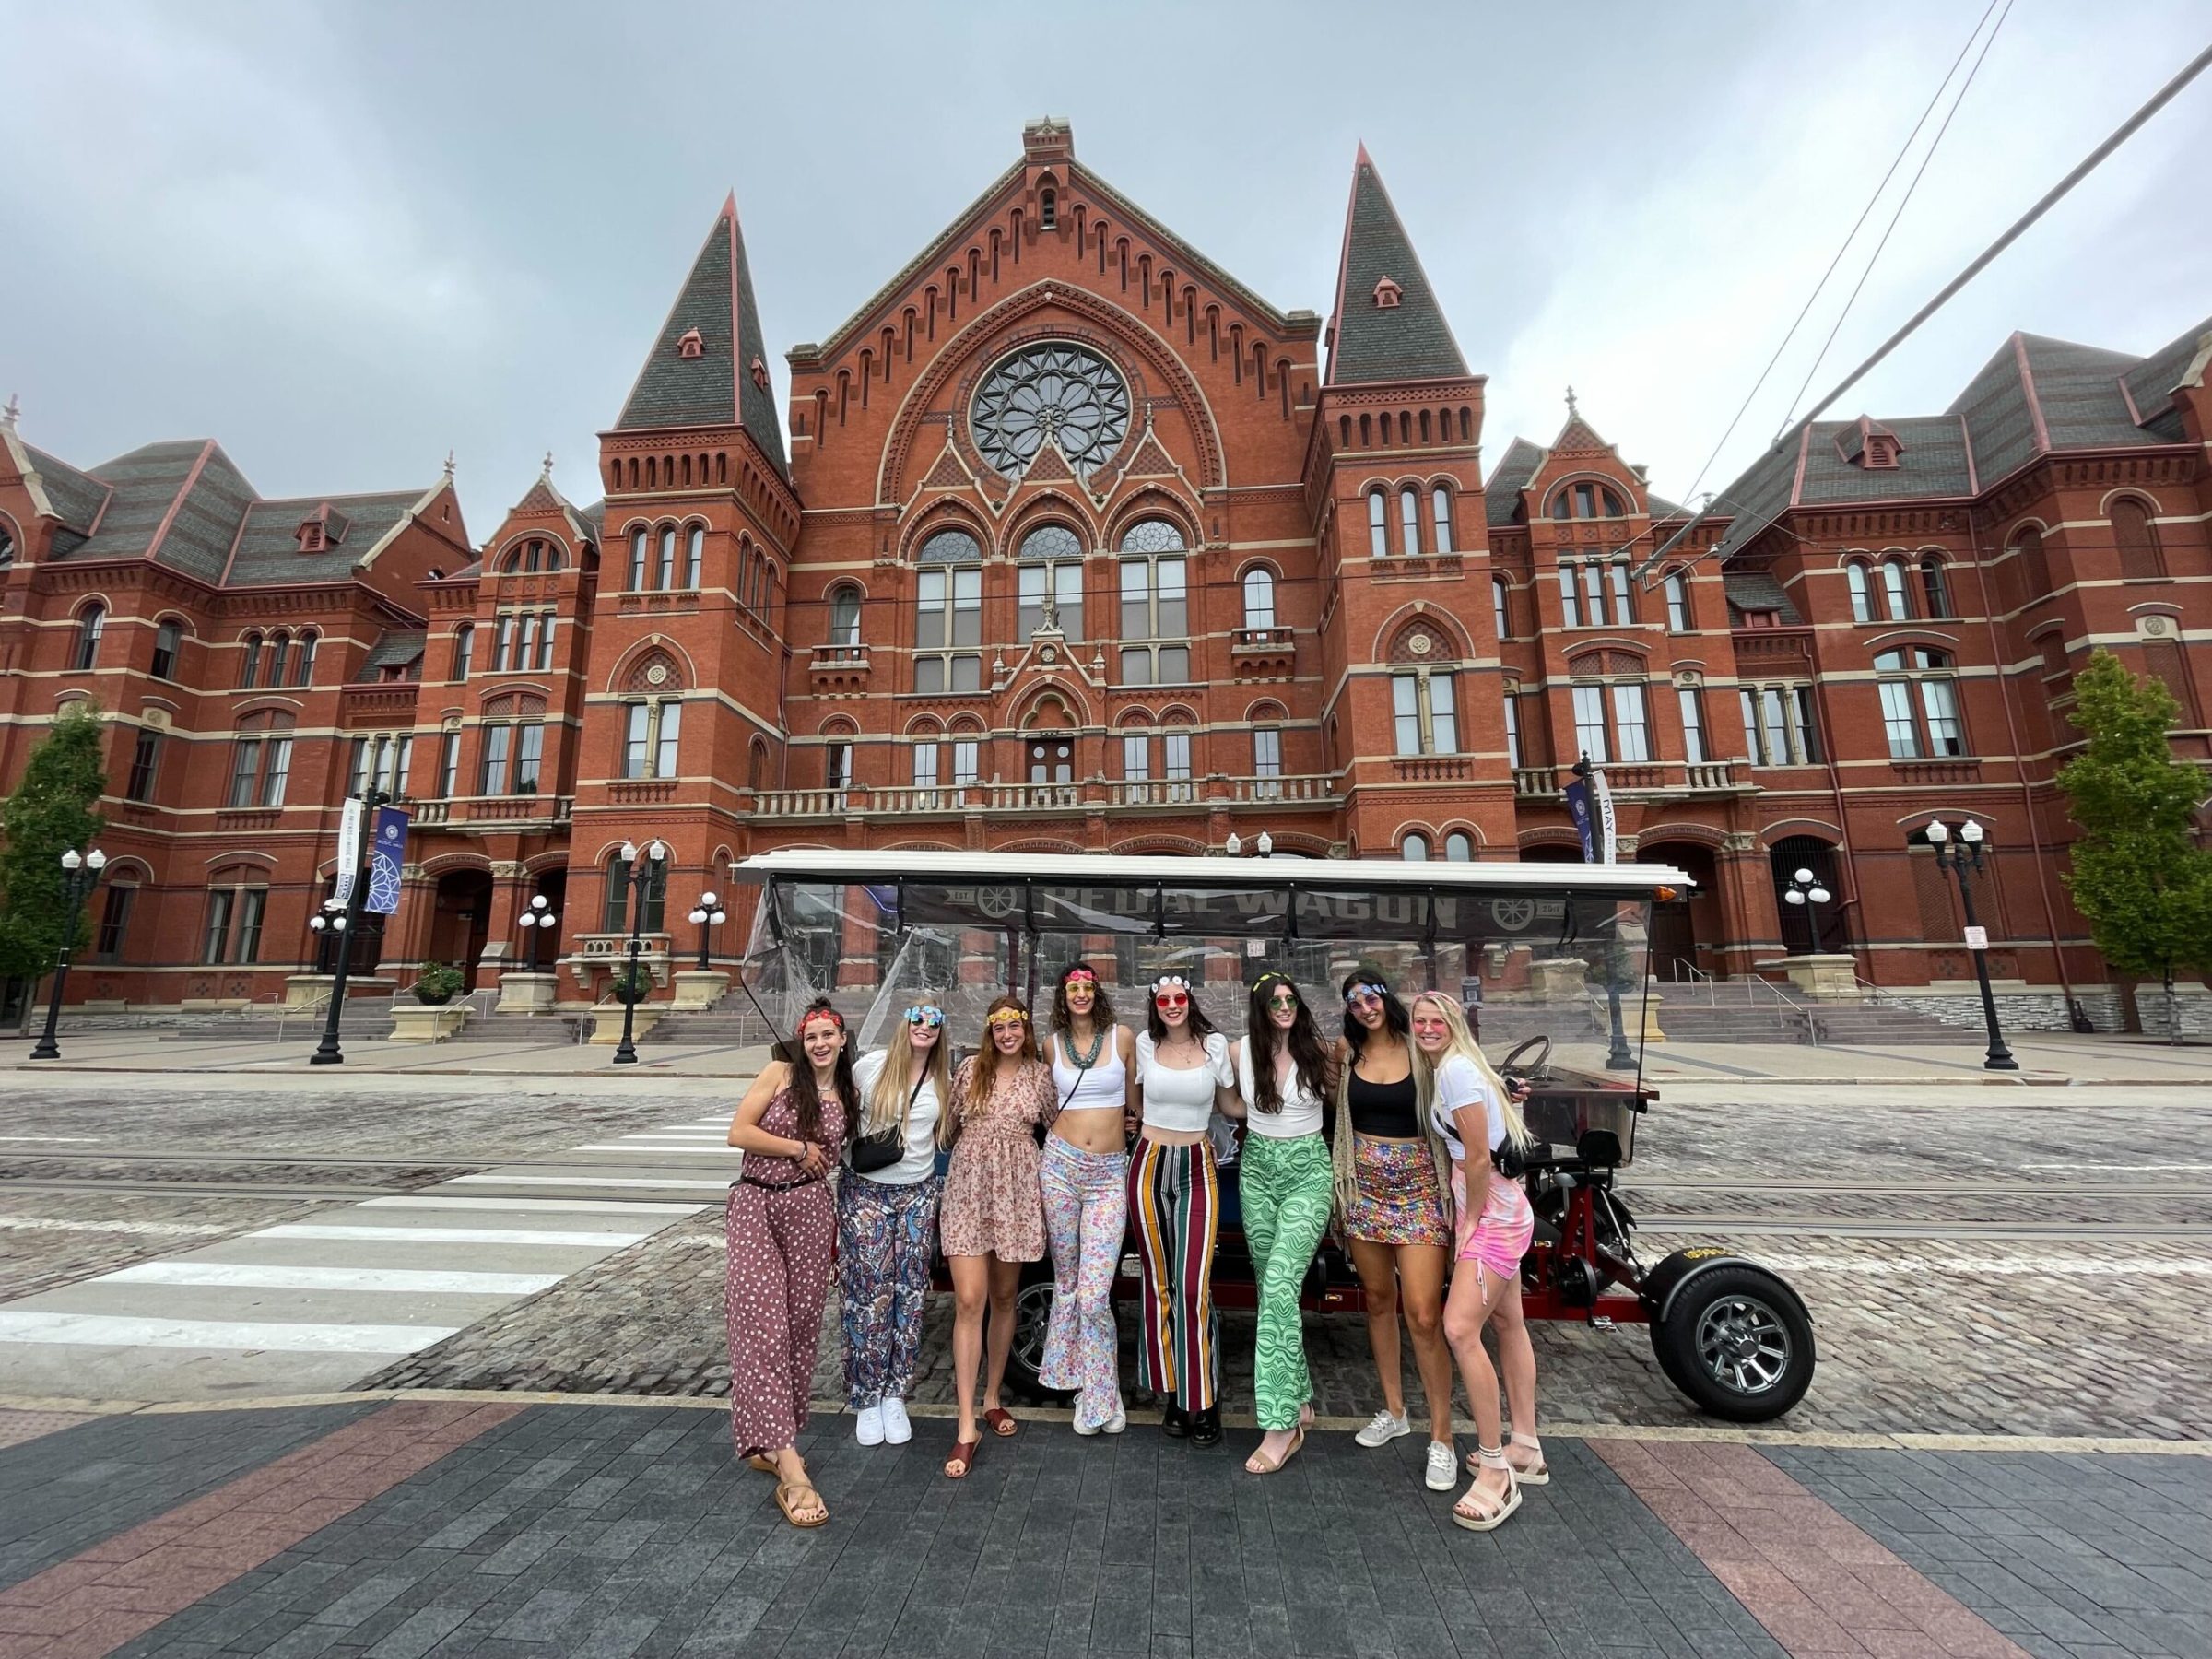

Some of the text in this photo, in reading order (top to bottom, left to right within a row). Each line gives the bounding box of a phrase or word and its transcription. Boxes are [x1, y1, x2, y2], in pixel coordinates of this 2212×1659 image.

[1603, 799, 1613, 832] MAY
[1043, 888, 1456, 929] PEDAL WAGON
